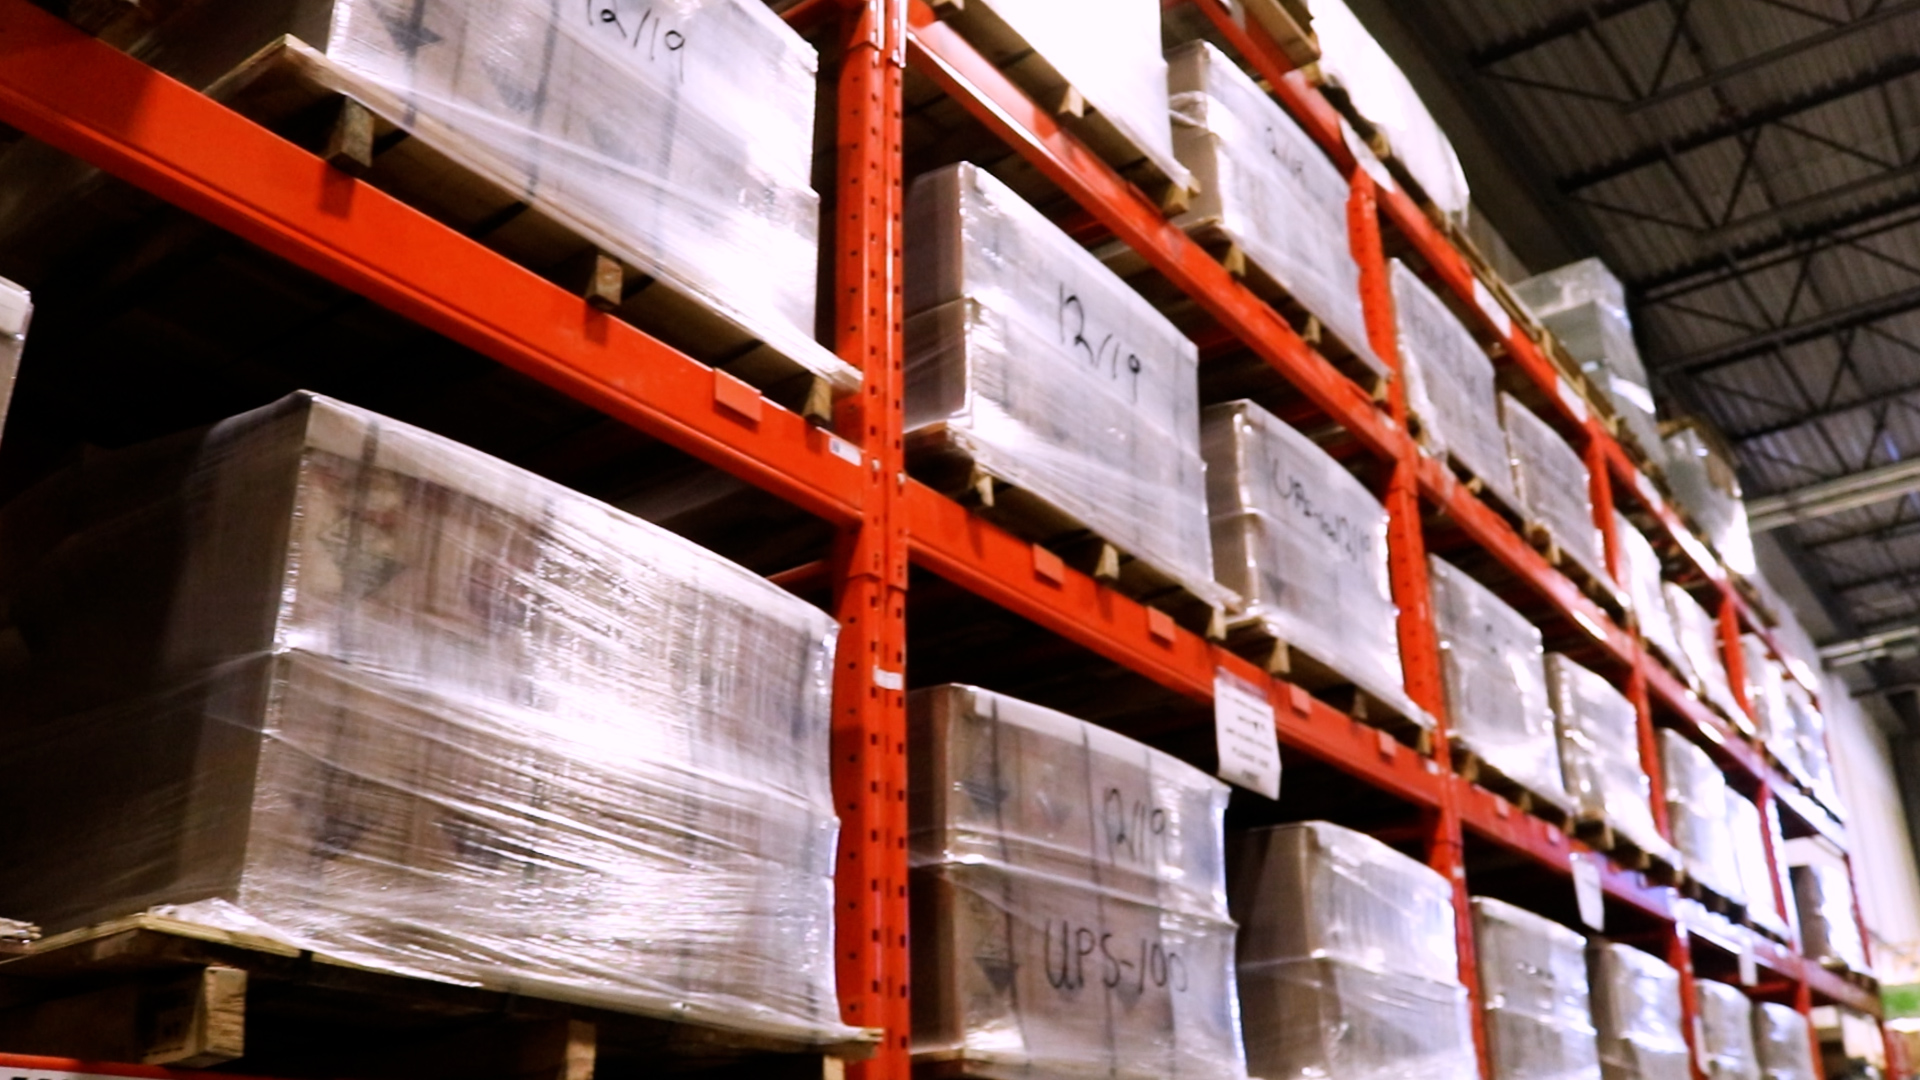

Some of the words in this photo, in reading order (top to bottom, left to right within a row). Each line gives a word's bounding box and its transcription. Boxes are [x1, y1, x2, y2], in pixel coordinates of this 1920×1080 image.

[1059, 281, 1141, 404] 12/19
[1104, 787, 1166, 866] 12/19
[1045, 921, 1188, 993] UPS-100
